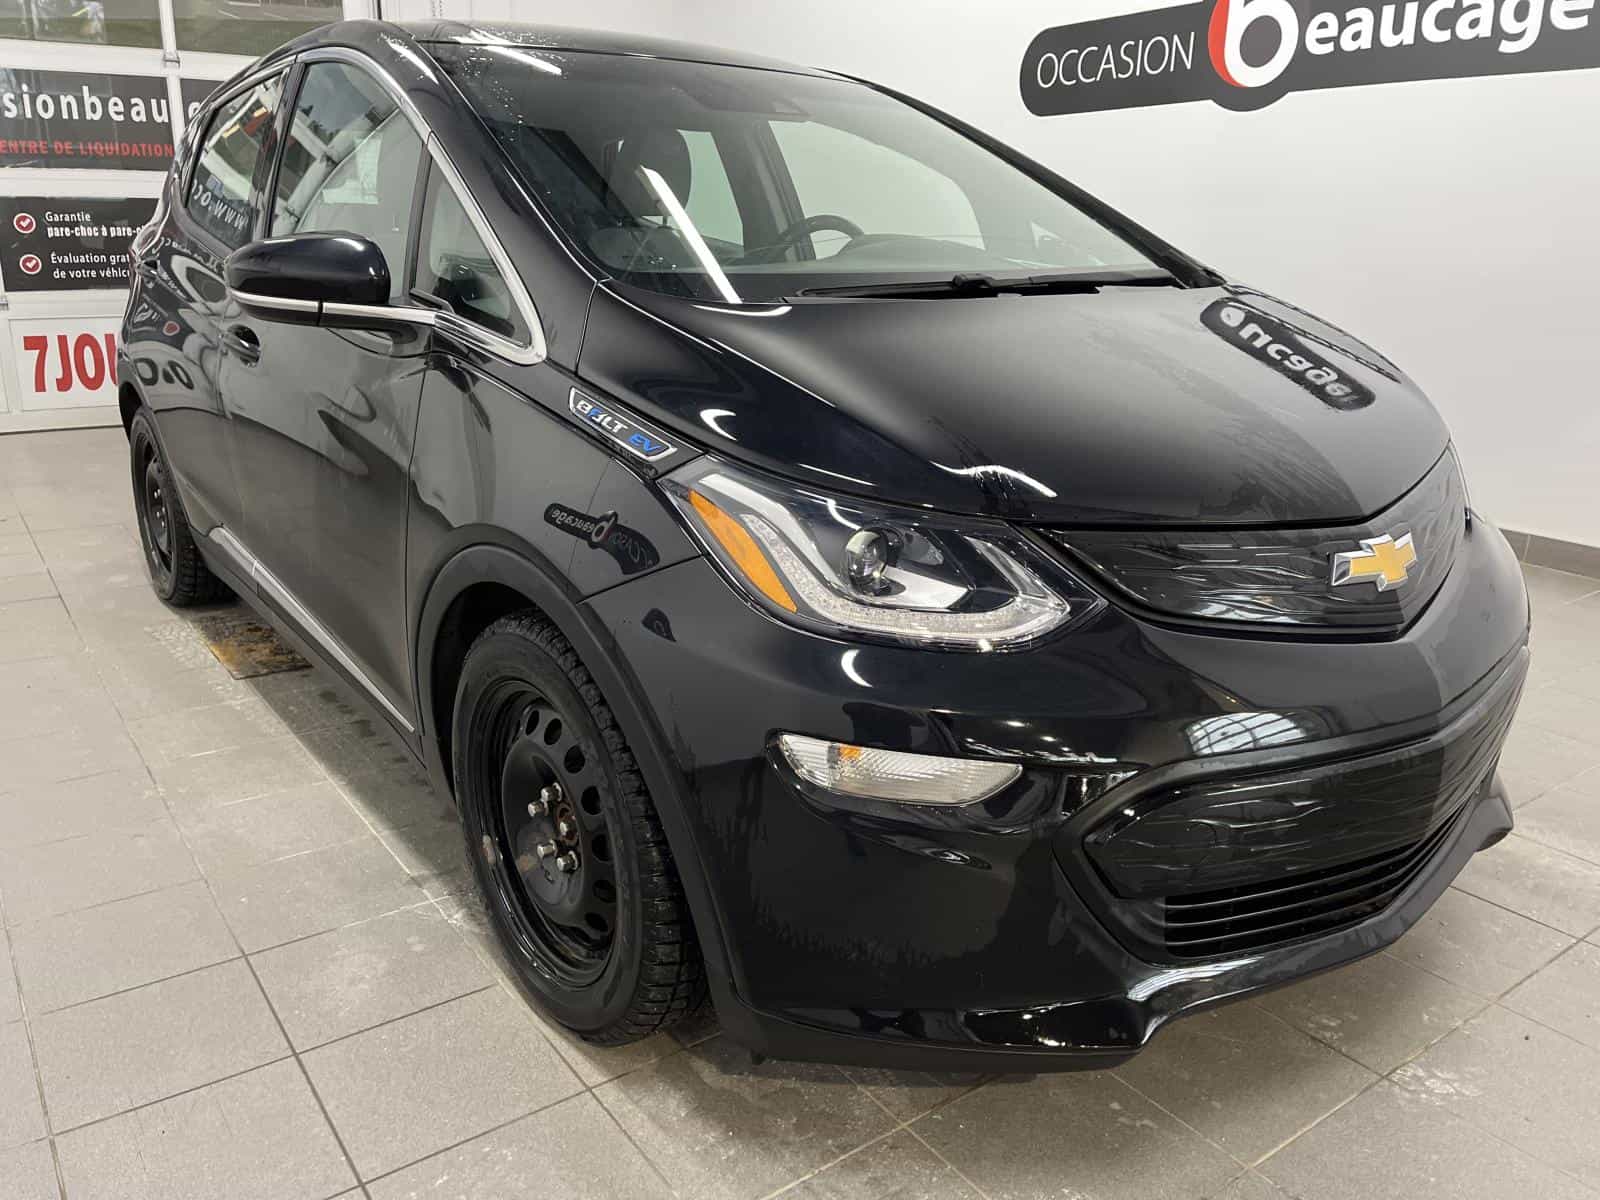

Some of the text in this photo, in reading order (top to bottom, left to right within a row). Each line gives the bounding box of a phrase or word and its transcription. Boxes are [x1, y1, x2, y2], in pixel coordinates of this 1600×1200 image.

[1036, 31, 1195, 88] OCCASION
[54, 141, 74, 155] DE
[80, 142, 174, 157] LIQUIDATION
[45, 211, 92, 222] Garantie
[47, 225, 99, 238] pare-choc
[102, 224, 108, 237] à
[51, 251, 107, 264] Évaluation
[53, 268, 66, 279] de
[69, 269, 97, 279] votre
[576, 399, 660, 452] BOLT EV
